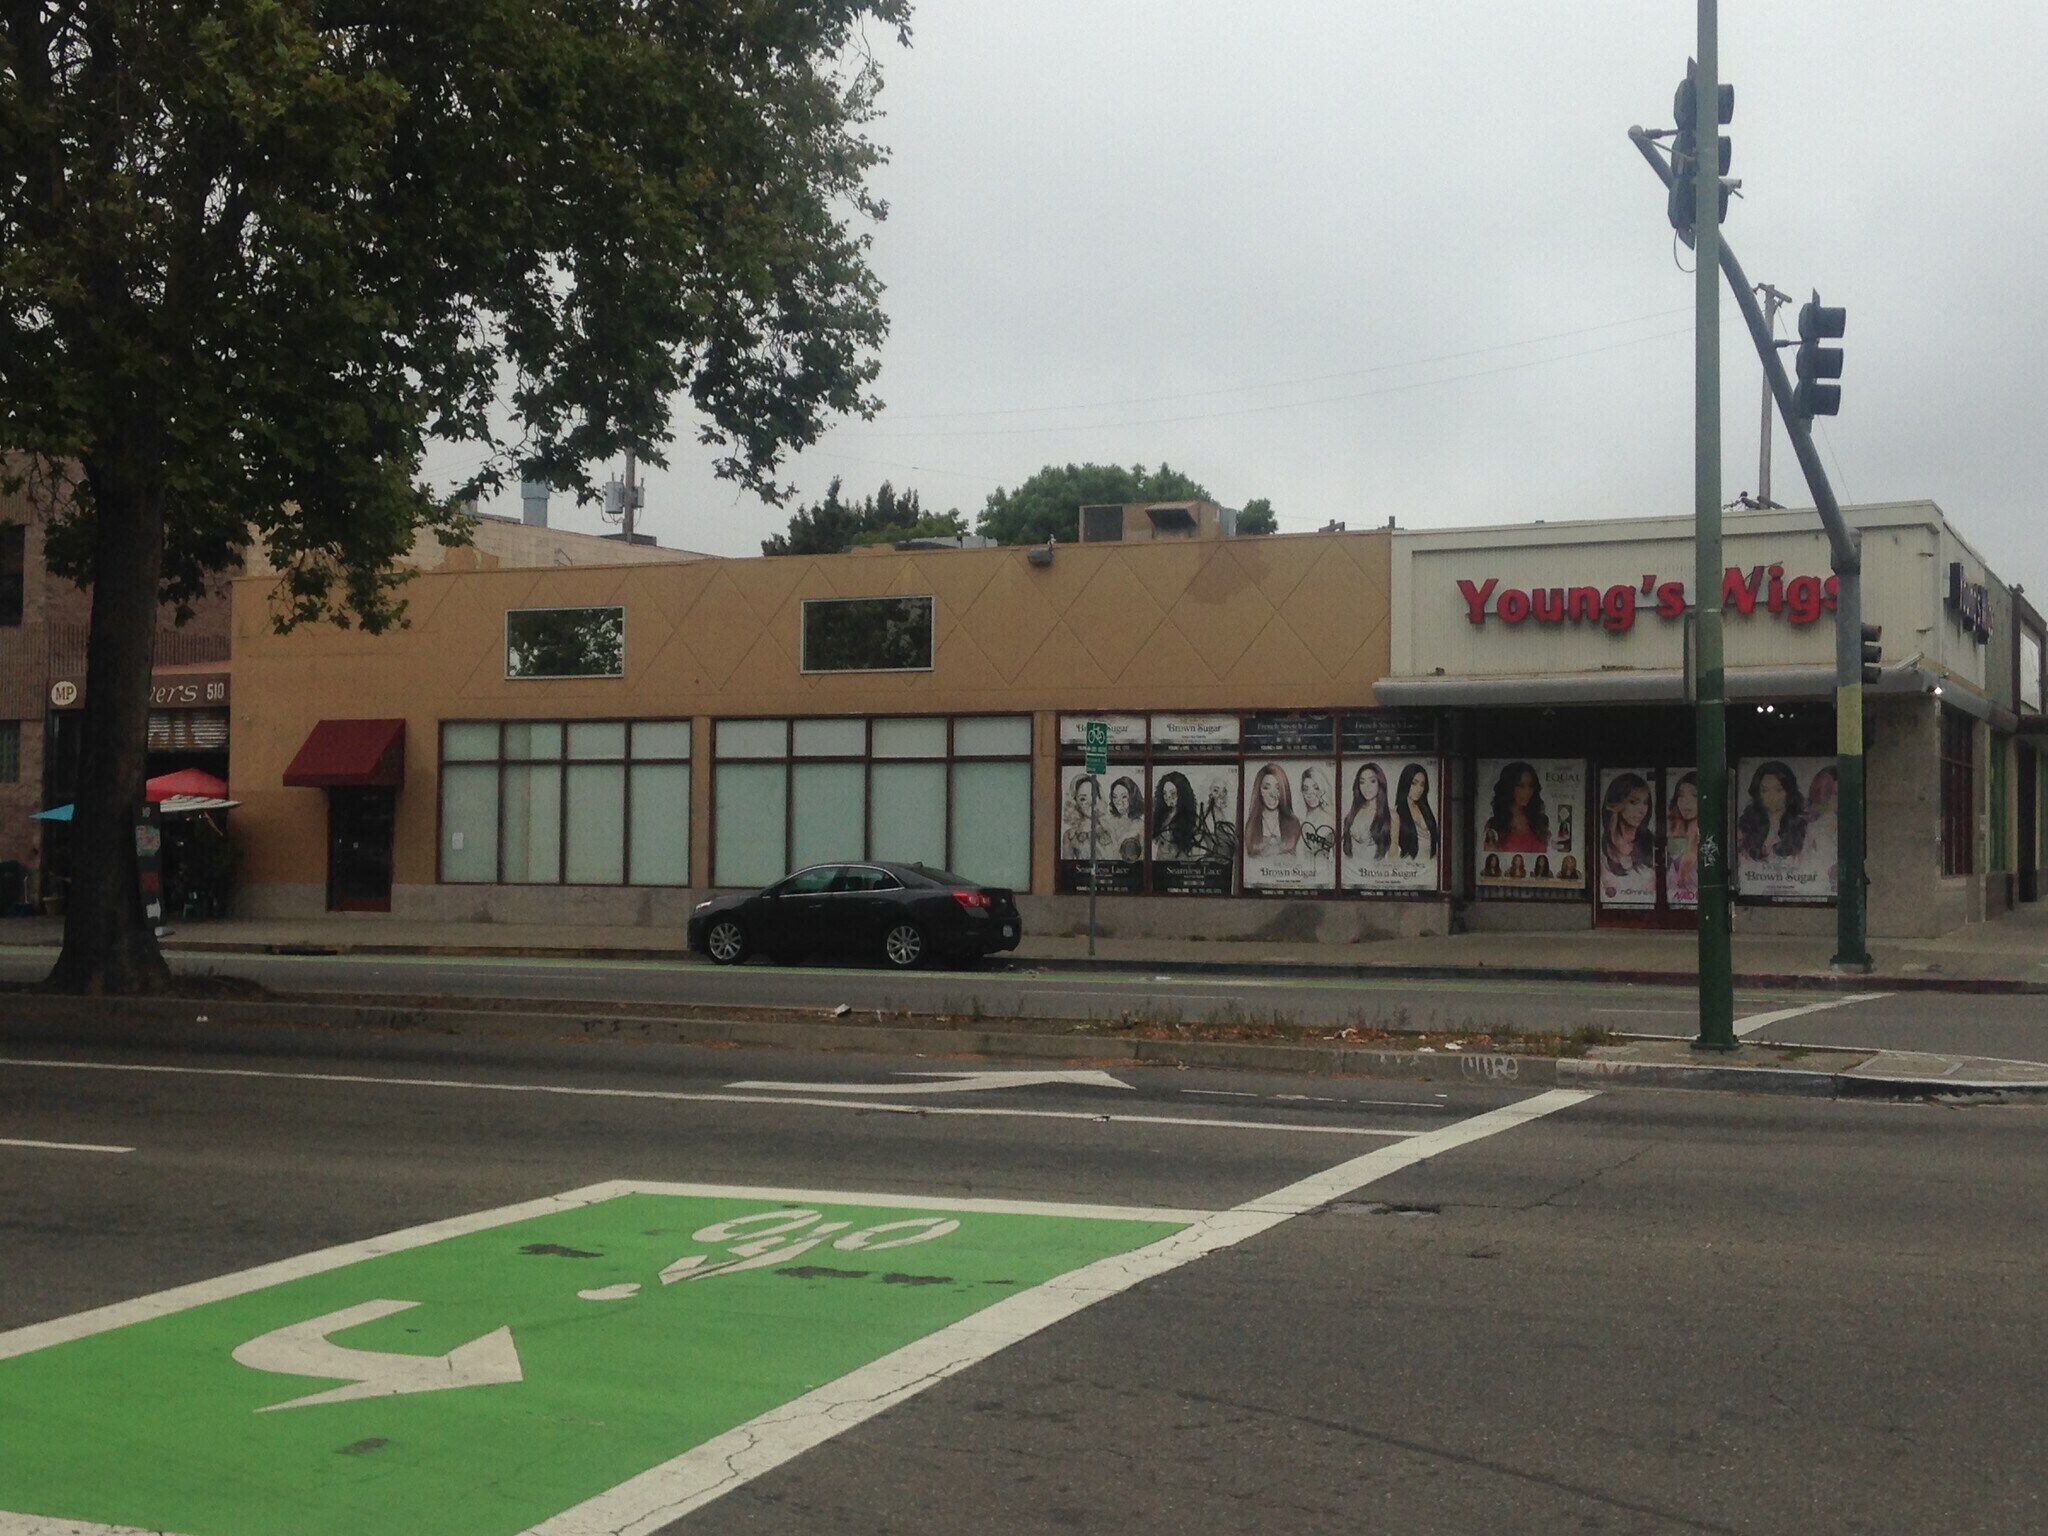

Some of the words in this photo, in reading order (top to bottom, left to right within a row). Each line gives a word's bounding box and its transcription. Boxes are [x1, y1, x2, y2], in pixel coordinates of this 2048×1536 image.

[1456, 574, 1686, 632] Young's
[54, 685, 75, 701] MP
[206, 682, 225, 700] 510
[1166, 723, 1196, 733] Brown
[1197, 722, 1222, 734] Sugar
[1545, 772, 1580, 784] EQUAL
[1111, 863, 1130, 874] Lace
[1166, 864, 1201, 875] Seamless
[1203, 864, 1222, 875] Lace
[1260, 867, 1291, 877] Brown
[1292, 866, 1316, 879] Sugar
[1358, 867, 1390, 878] Brown
[1391, 867, 1418, 880] Sugar
[1744, 870, 1783, 882] Brown
[1785, 870, 1818, 883] Sugar
